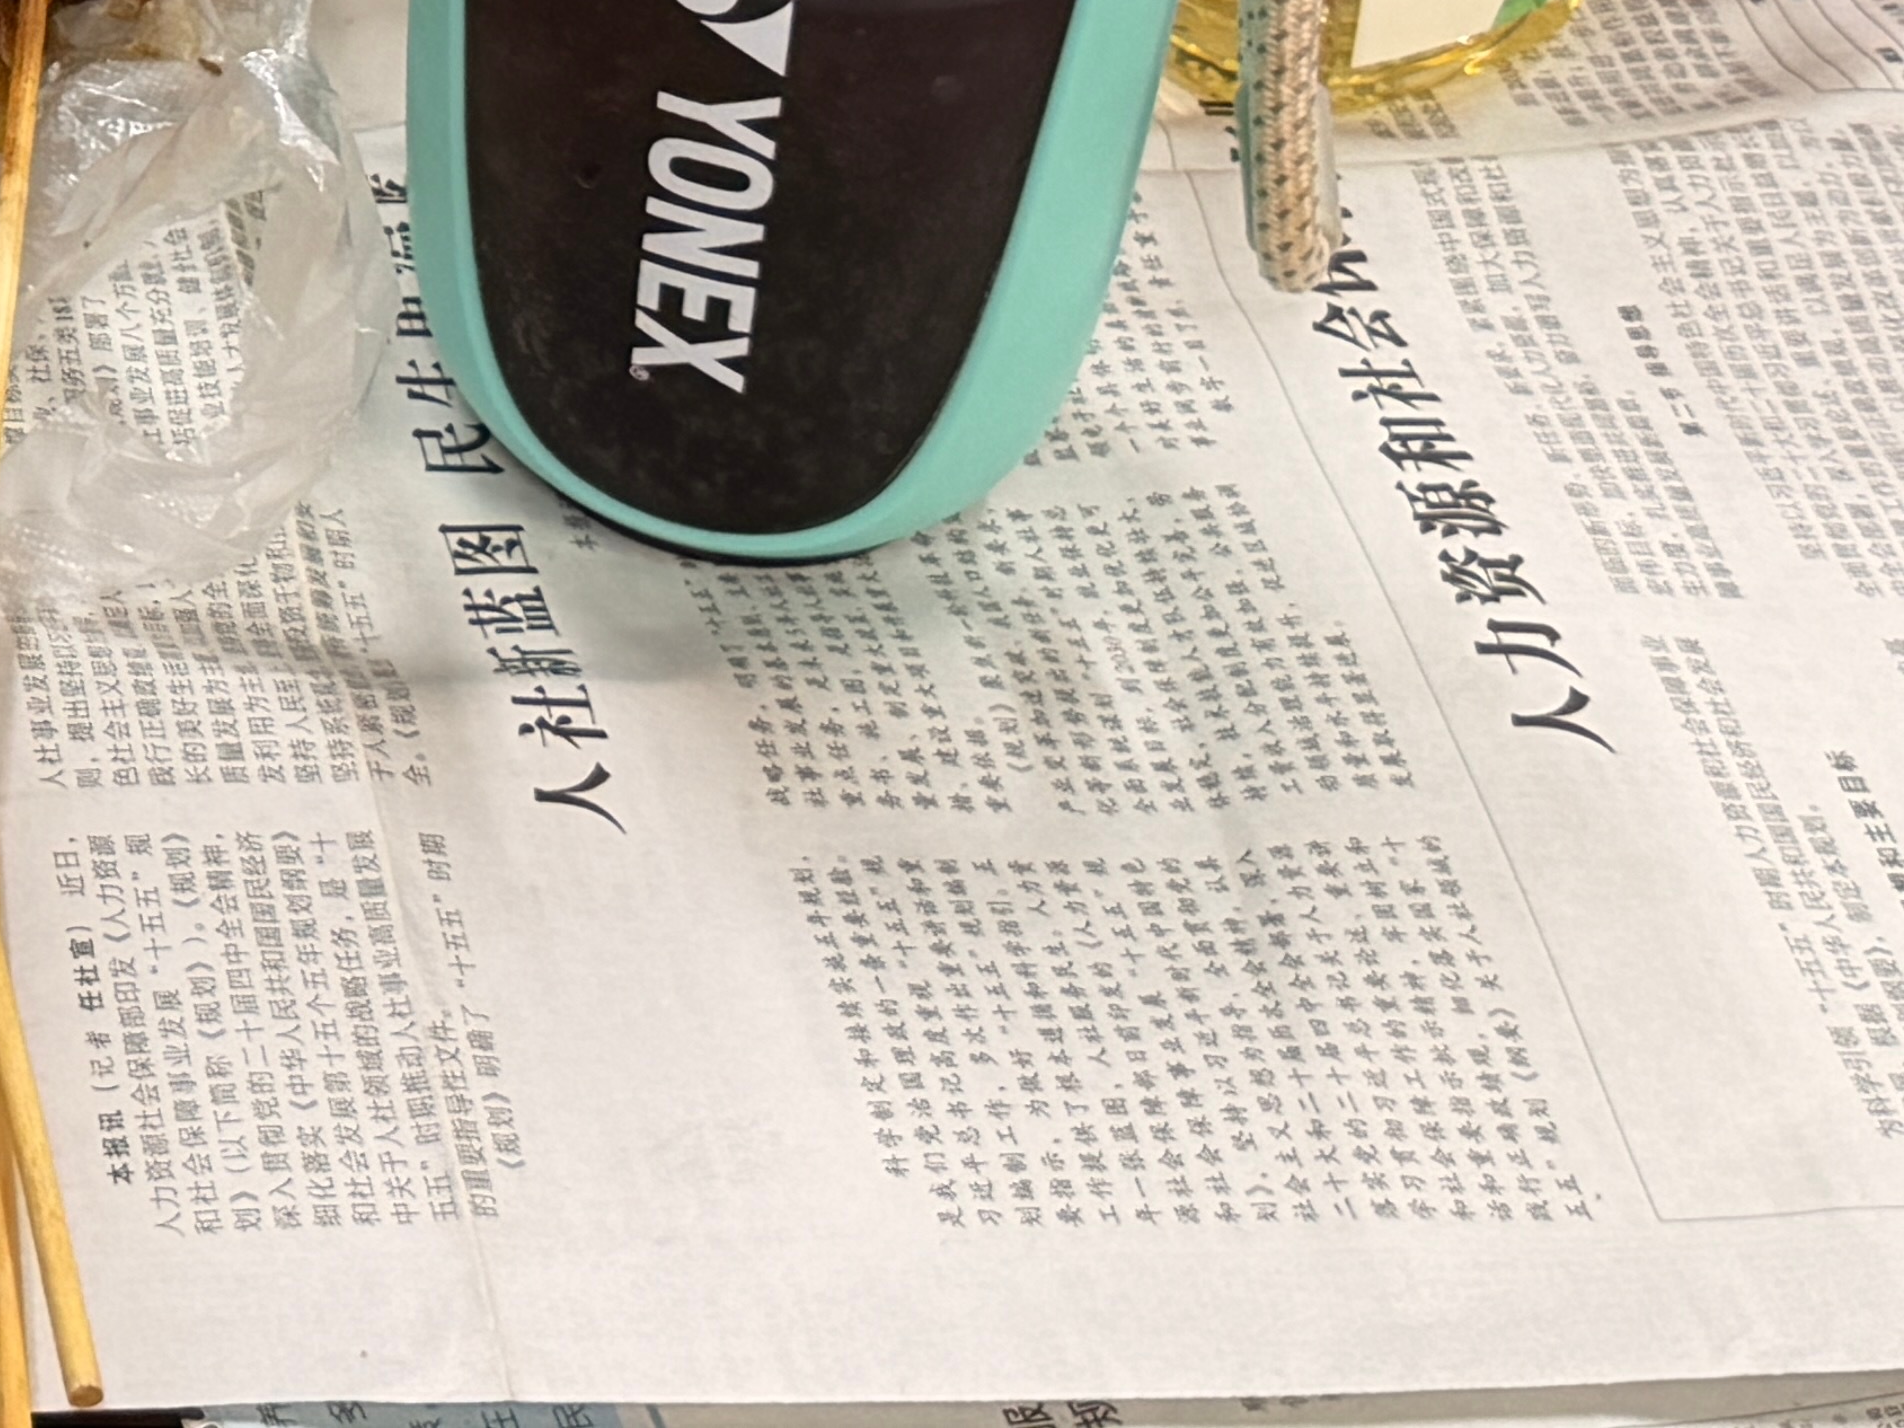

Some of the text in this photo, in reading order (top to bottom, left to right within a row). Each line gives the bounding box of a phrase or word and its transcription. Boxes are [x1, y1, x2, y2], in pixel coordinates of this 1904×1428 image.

[634, 87, 784, 395] YONEX
[437, 517, 627, 834] 人社新蓝图
